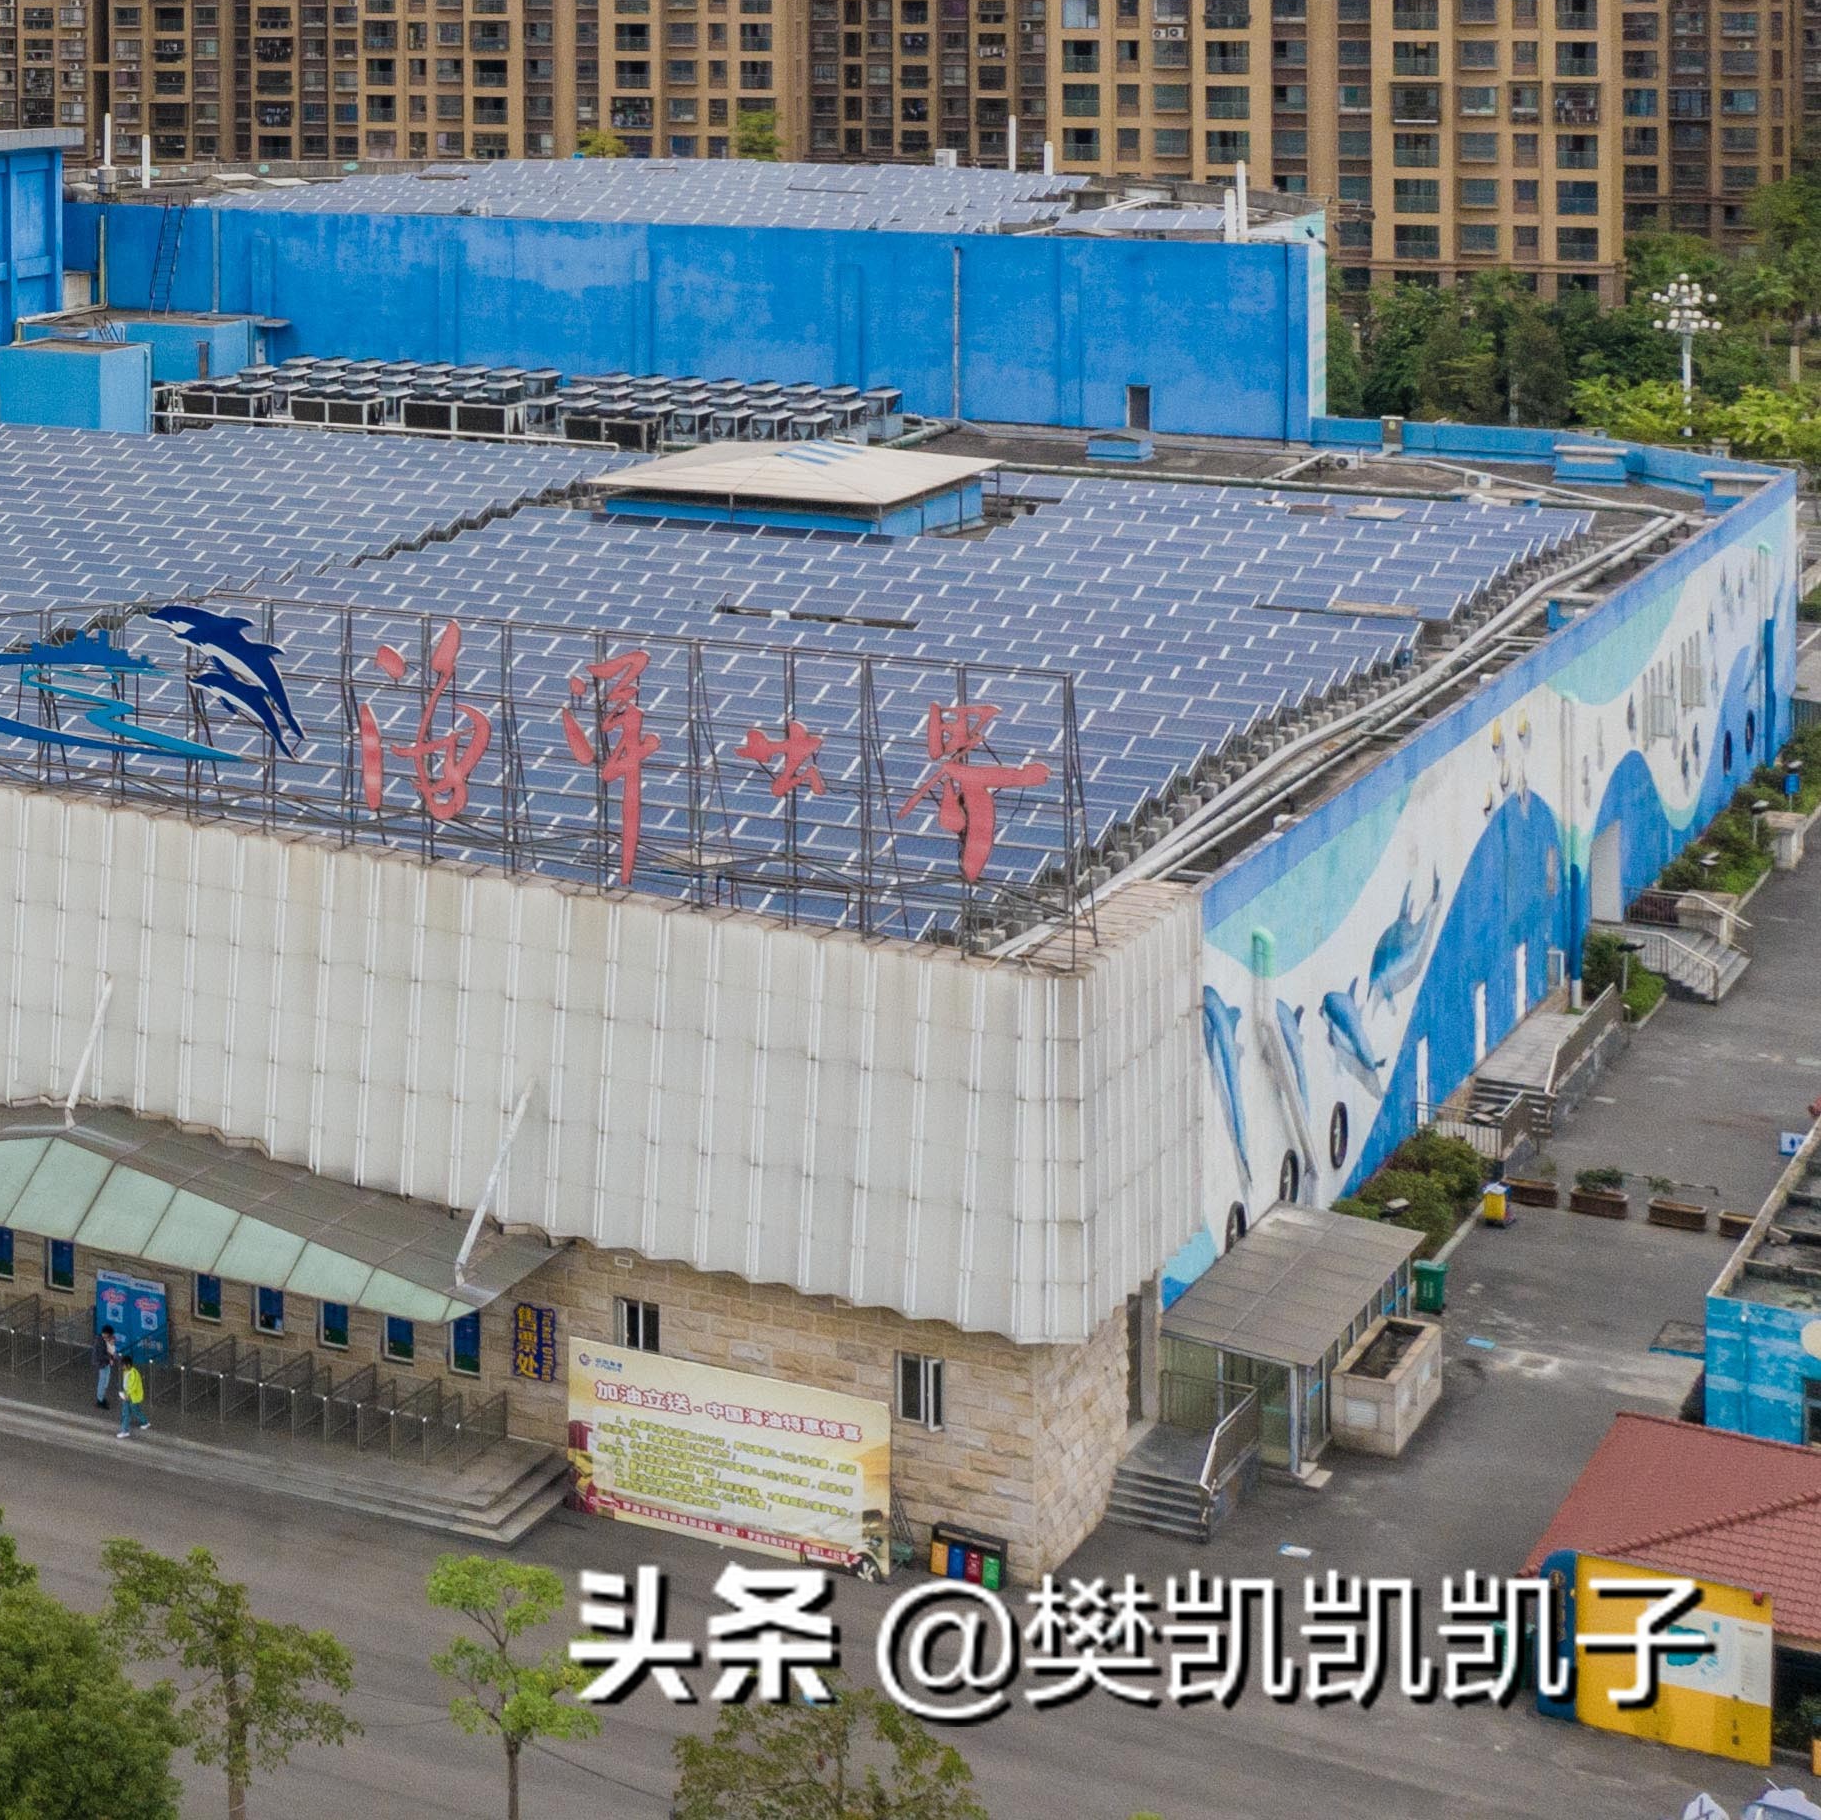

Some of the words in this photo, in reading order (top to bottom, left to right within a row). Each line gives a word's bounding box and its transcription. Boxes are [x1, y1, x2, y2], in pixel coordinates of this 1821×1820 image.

[360, 619, 1053, 884] 海洋世界
[517, 1305, 538, 1379] 售票处
